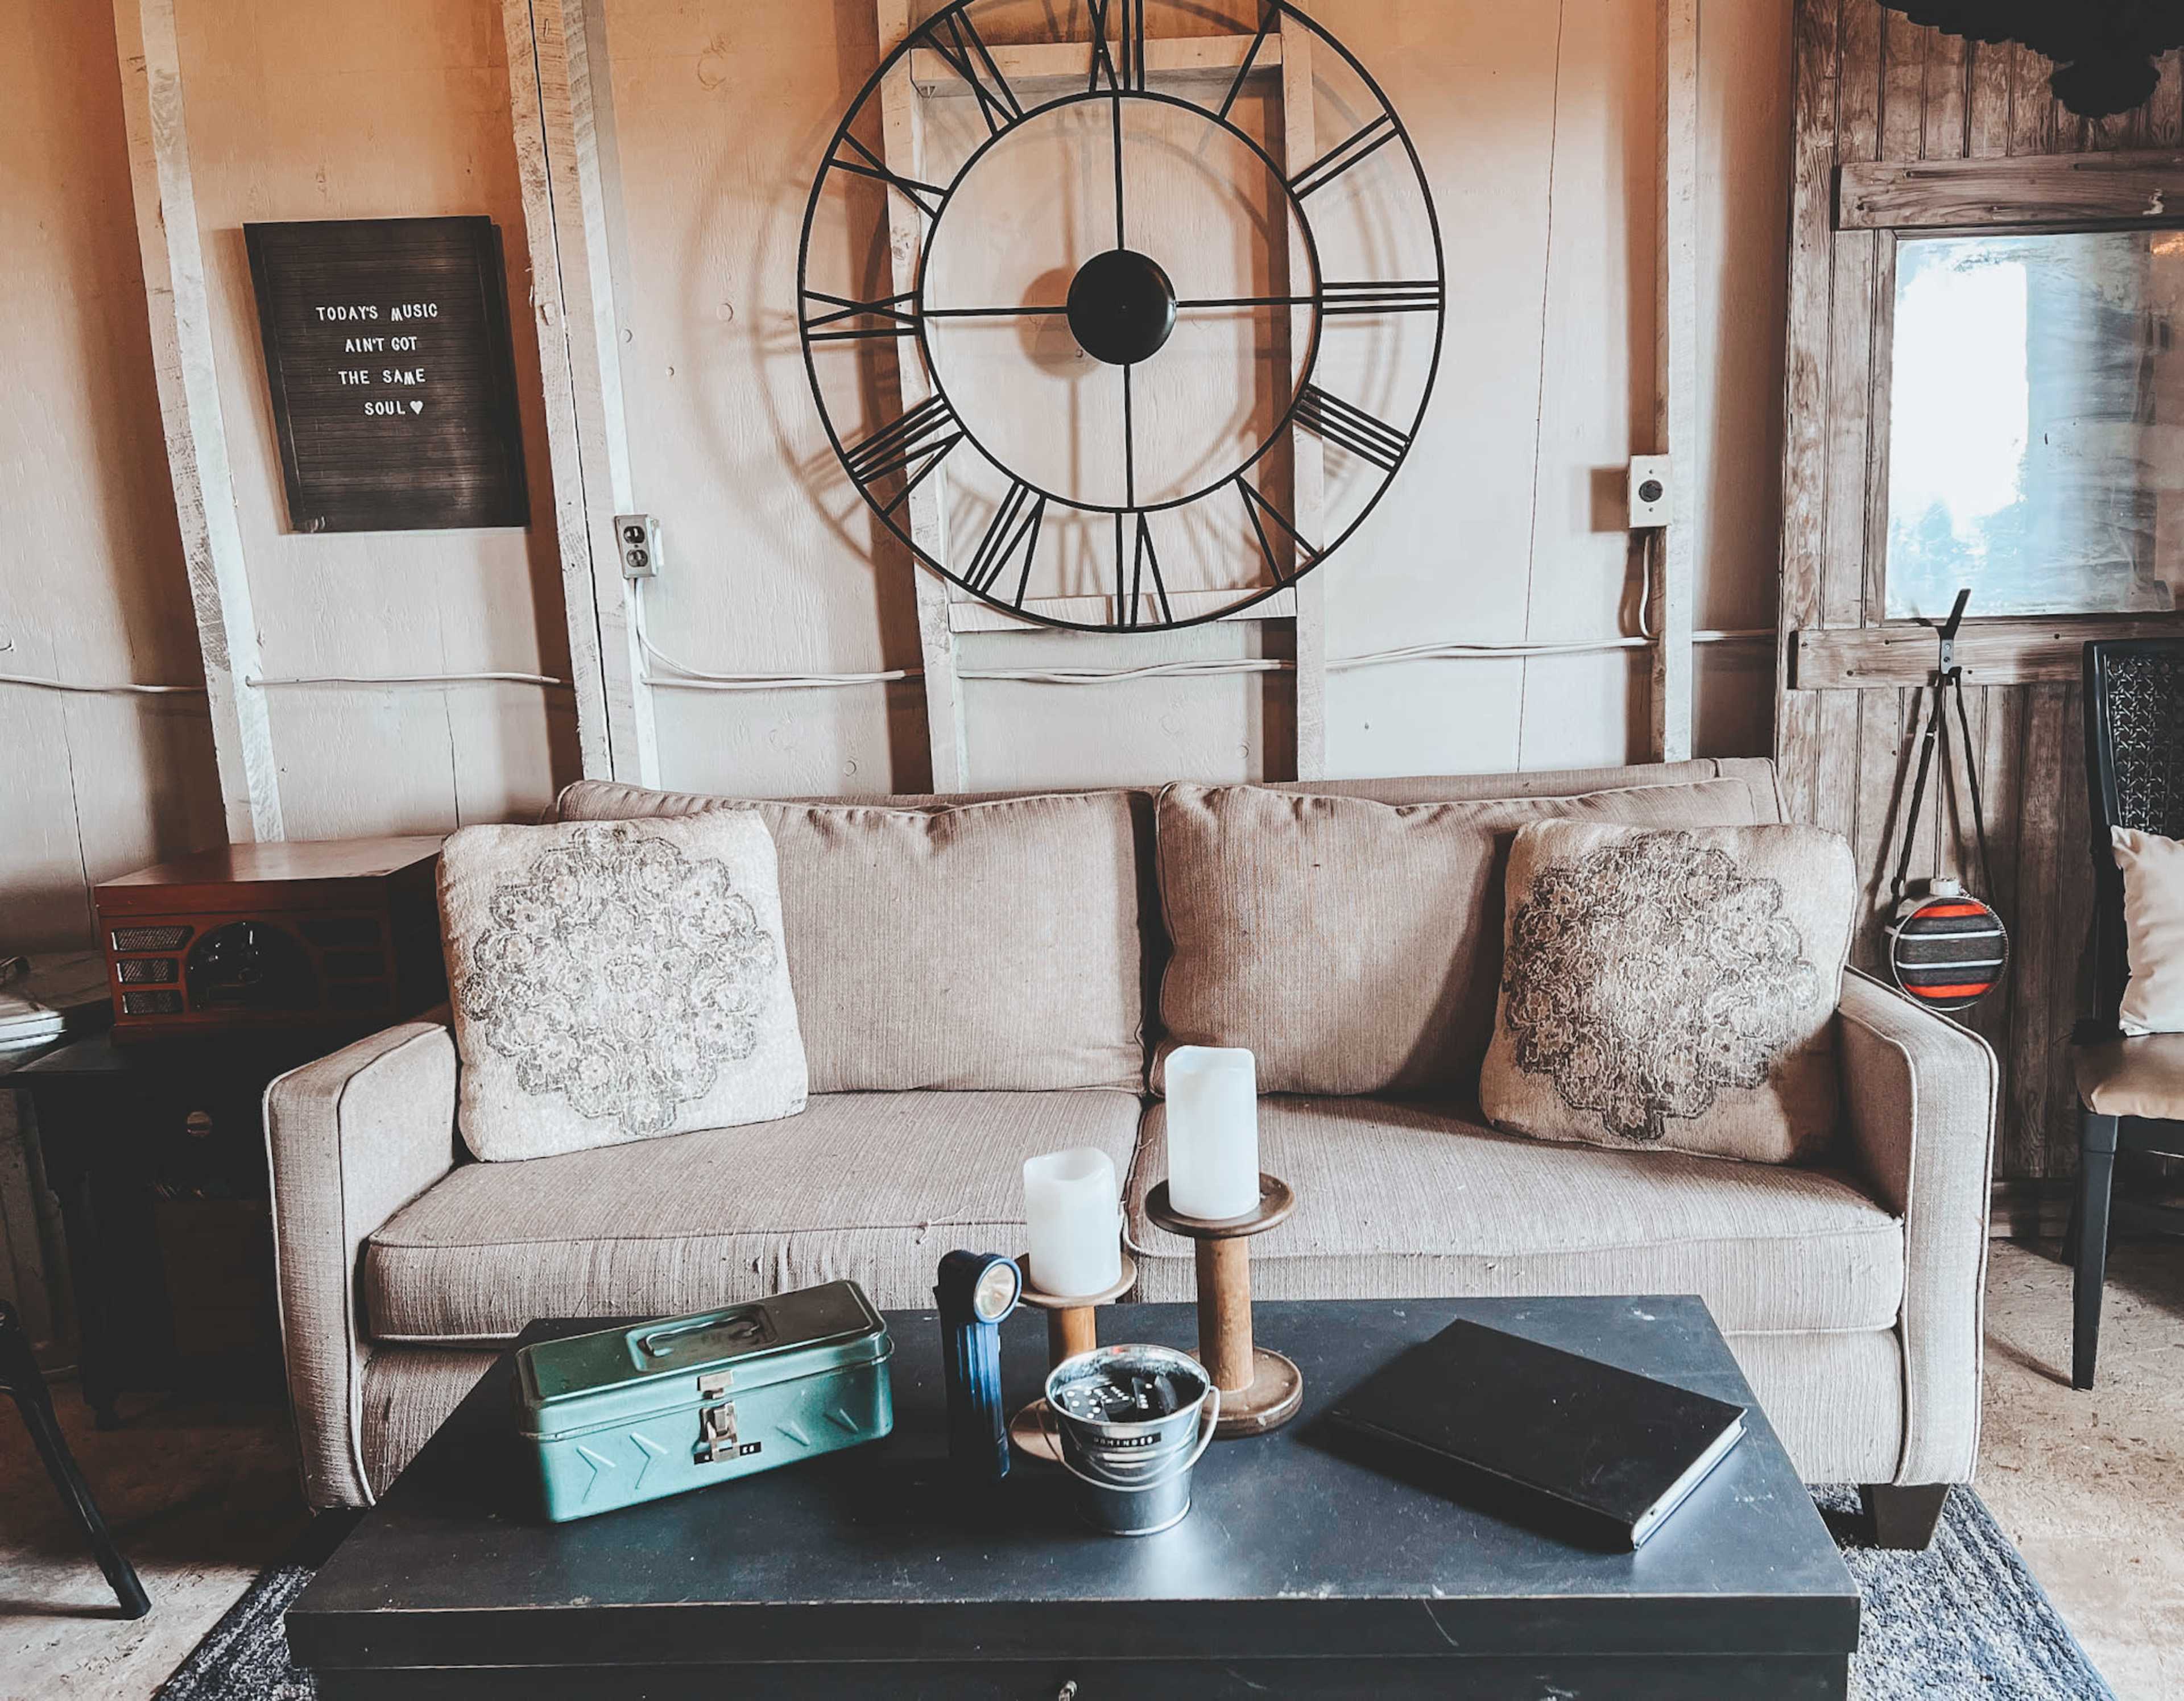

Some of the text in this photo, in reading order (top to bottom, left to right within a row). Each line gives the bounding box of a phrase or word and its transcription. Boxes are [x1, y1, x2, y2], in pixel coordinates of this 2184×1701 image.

[391, 303, 438, 321] MUSIC
[345, 337, 417, 353] AIN'T GOT
[338, 369, 425, 386] THE SAME
[365, 400, 406, 416] SOUL
